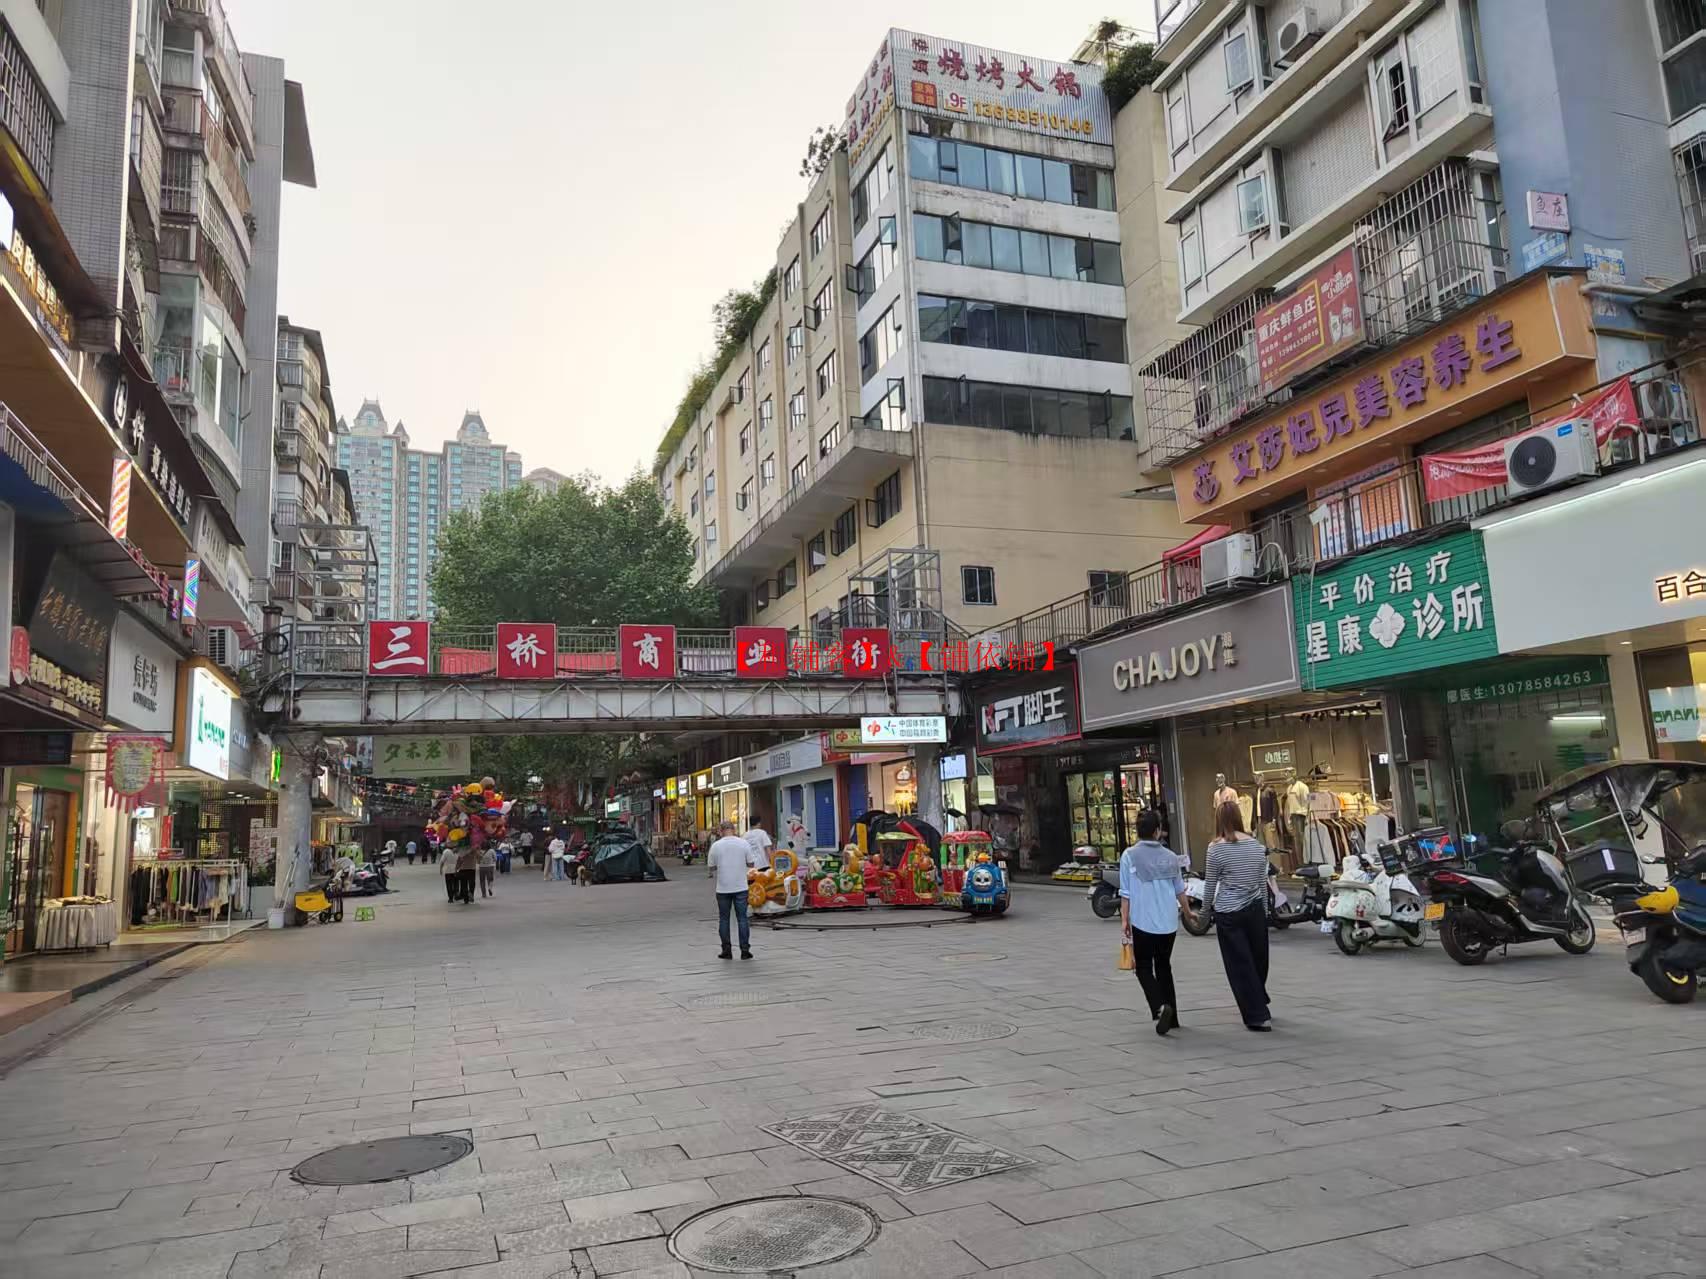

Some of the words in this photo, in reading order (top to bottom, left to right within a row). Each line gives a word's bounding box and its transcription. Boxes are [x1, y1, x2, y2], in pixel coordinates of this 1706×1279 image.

[1319, 551, 1451, 611] 平价治疗
[1655, 570, 1706, 601] 百合
[1112, 634, 1219, 692] CHAJOY
